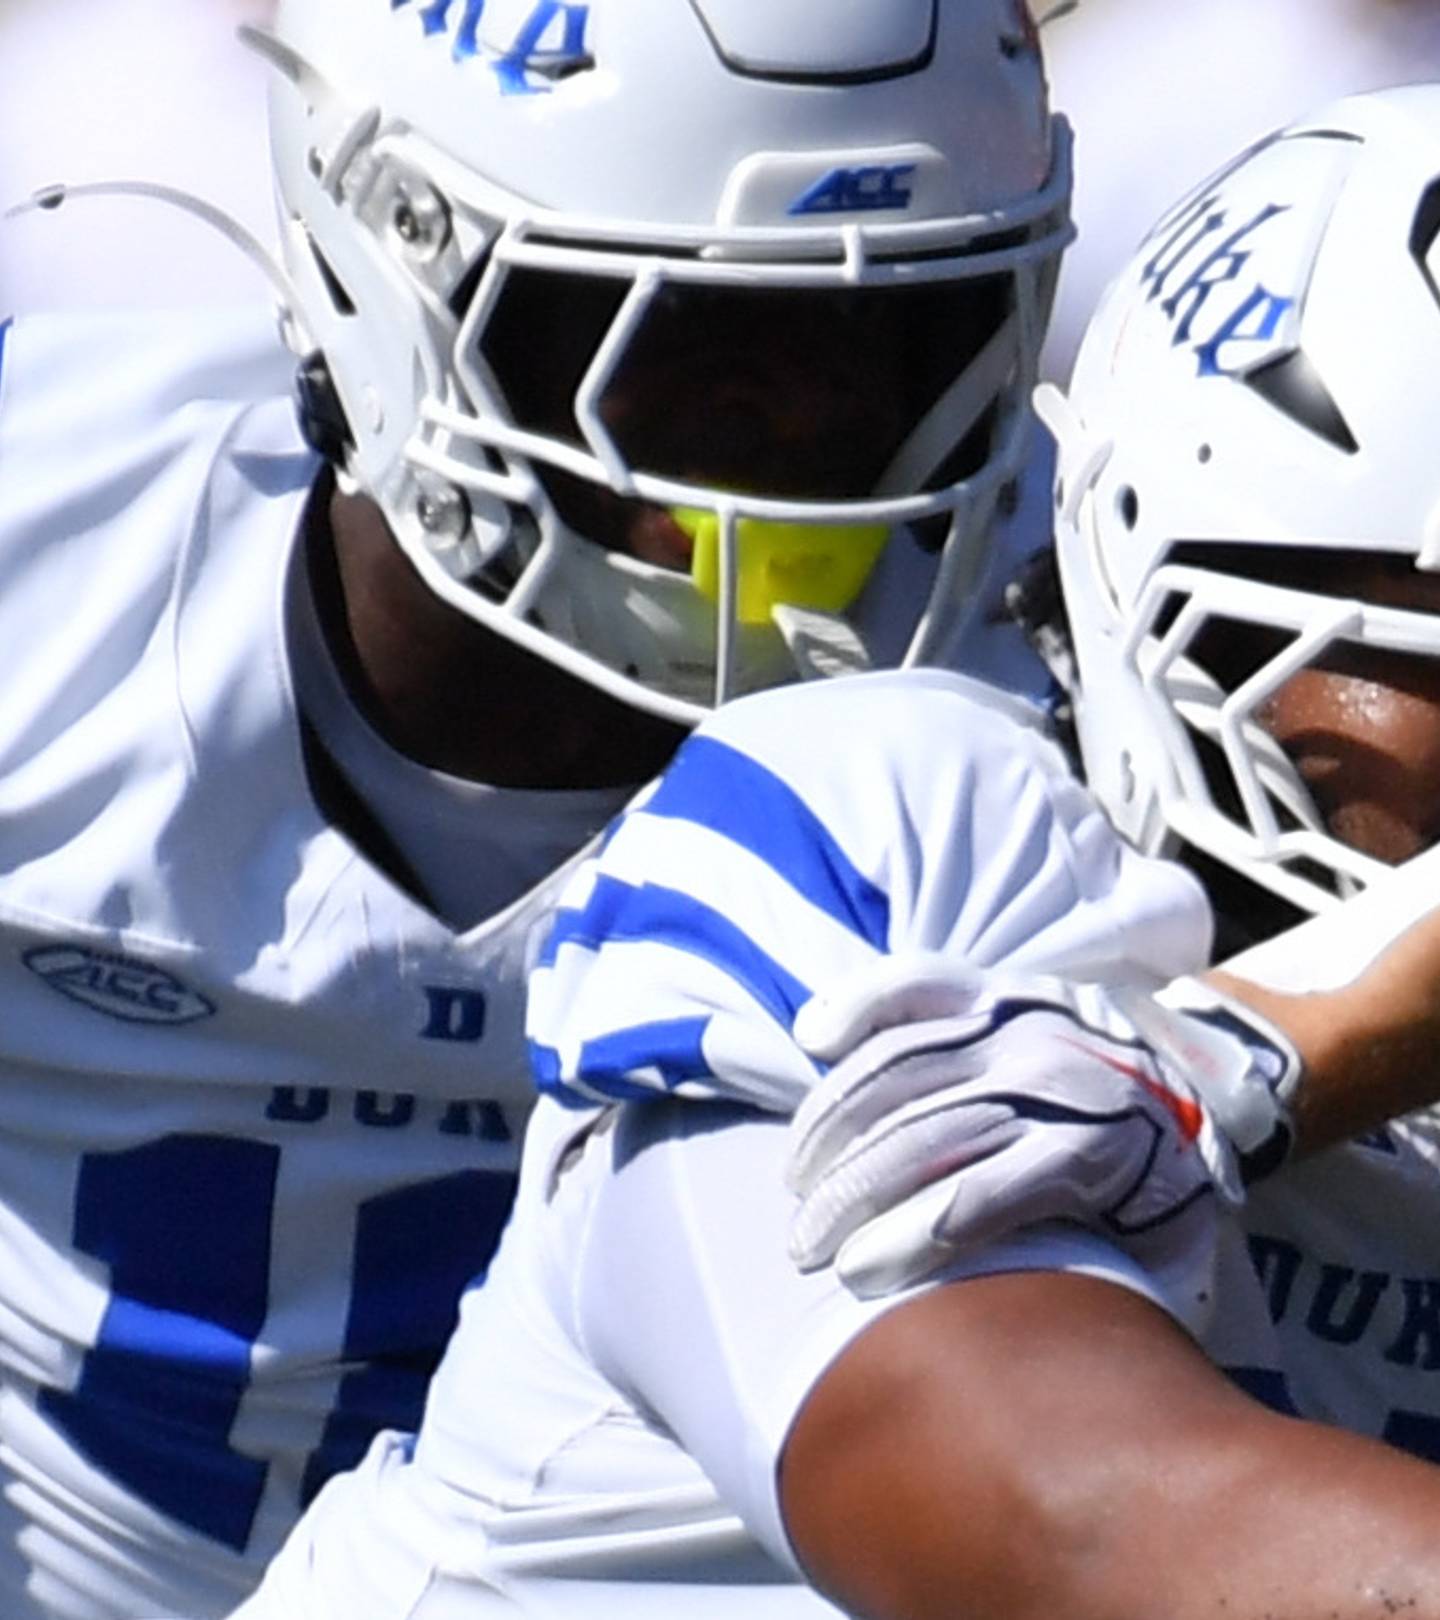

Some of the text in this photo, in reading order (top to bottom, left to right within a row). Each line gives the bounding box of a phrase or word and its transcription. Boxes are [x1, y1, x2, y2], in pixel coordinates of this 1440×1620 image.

[787, 163, 917, 215] ACC
[36, 954, 187, 1016] ACC
[418, 984, 487, 1043] D
